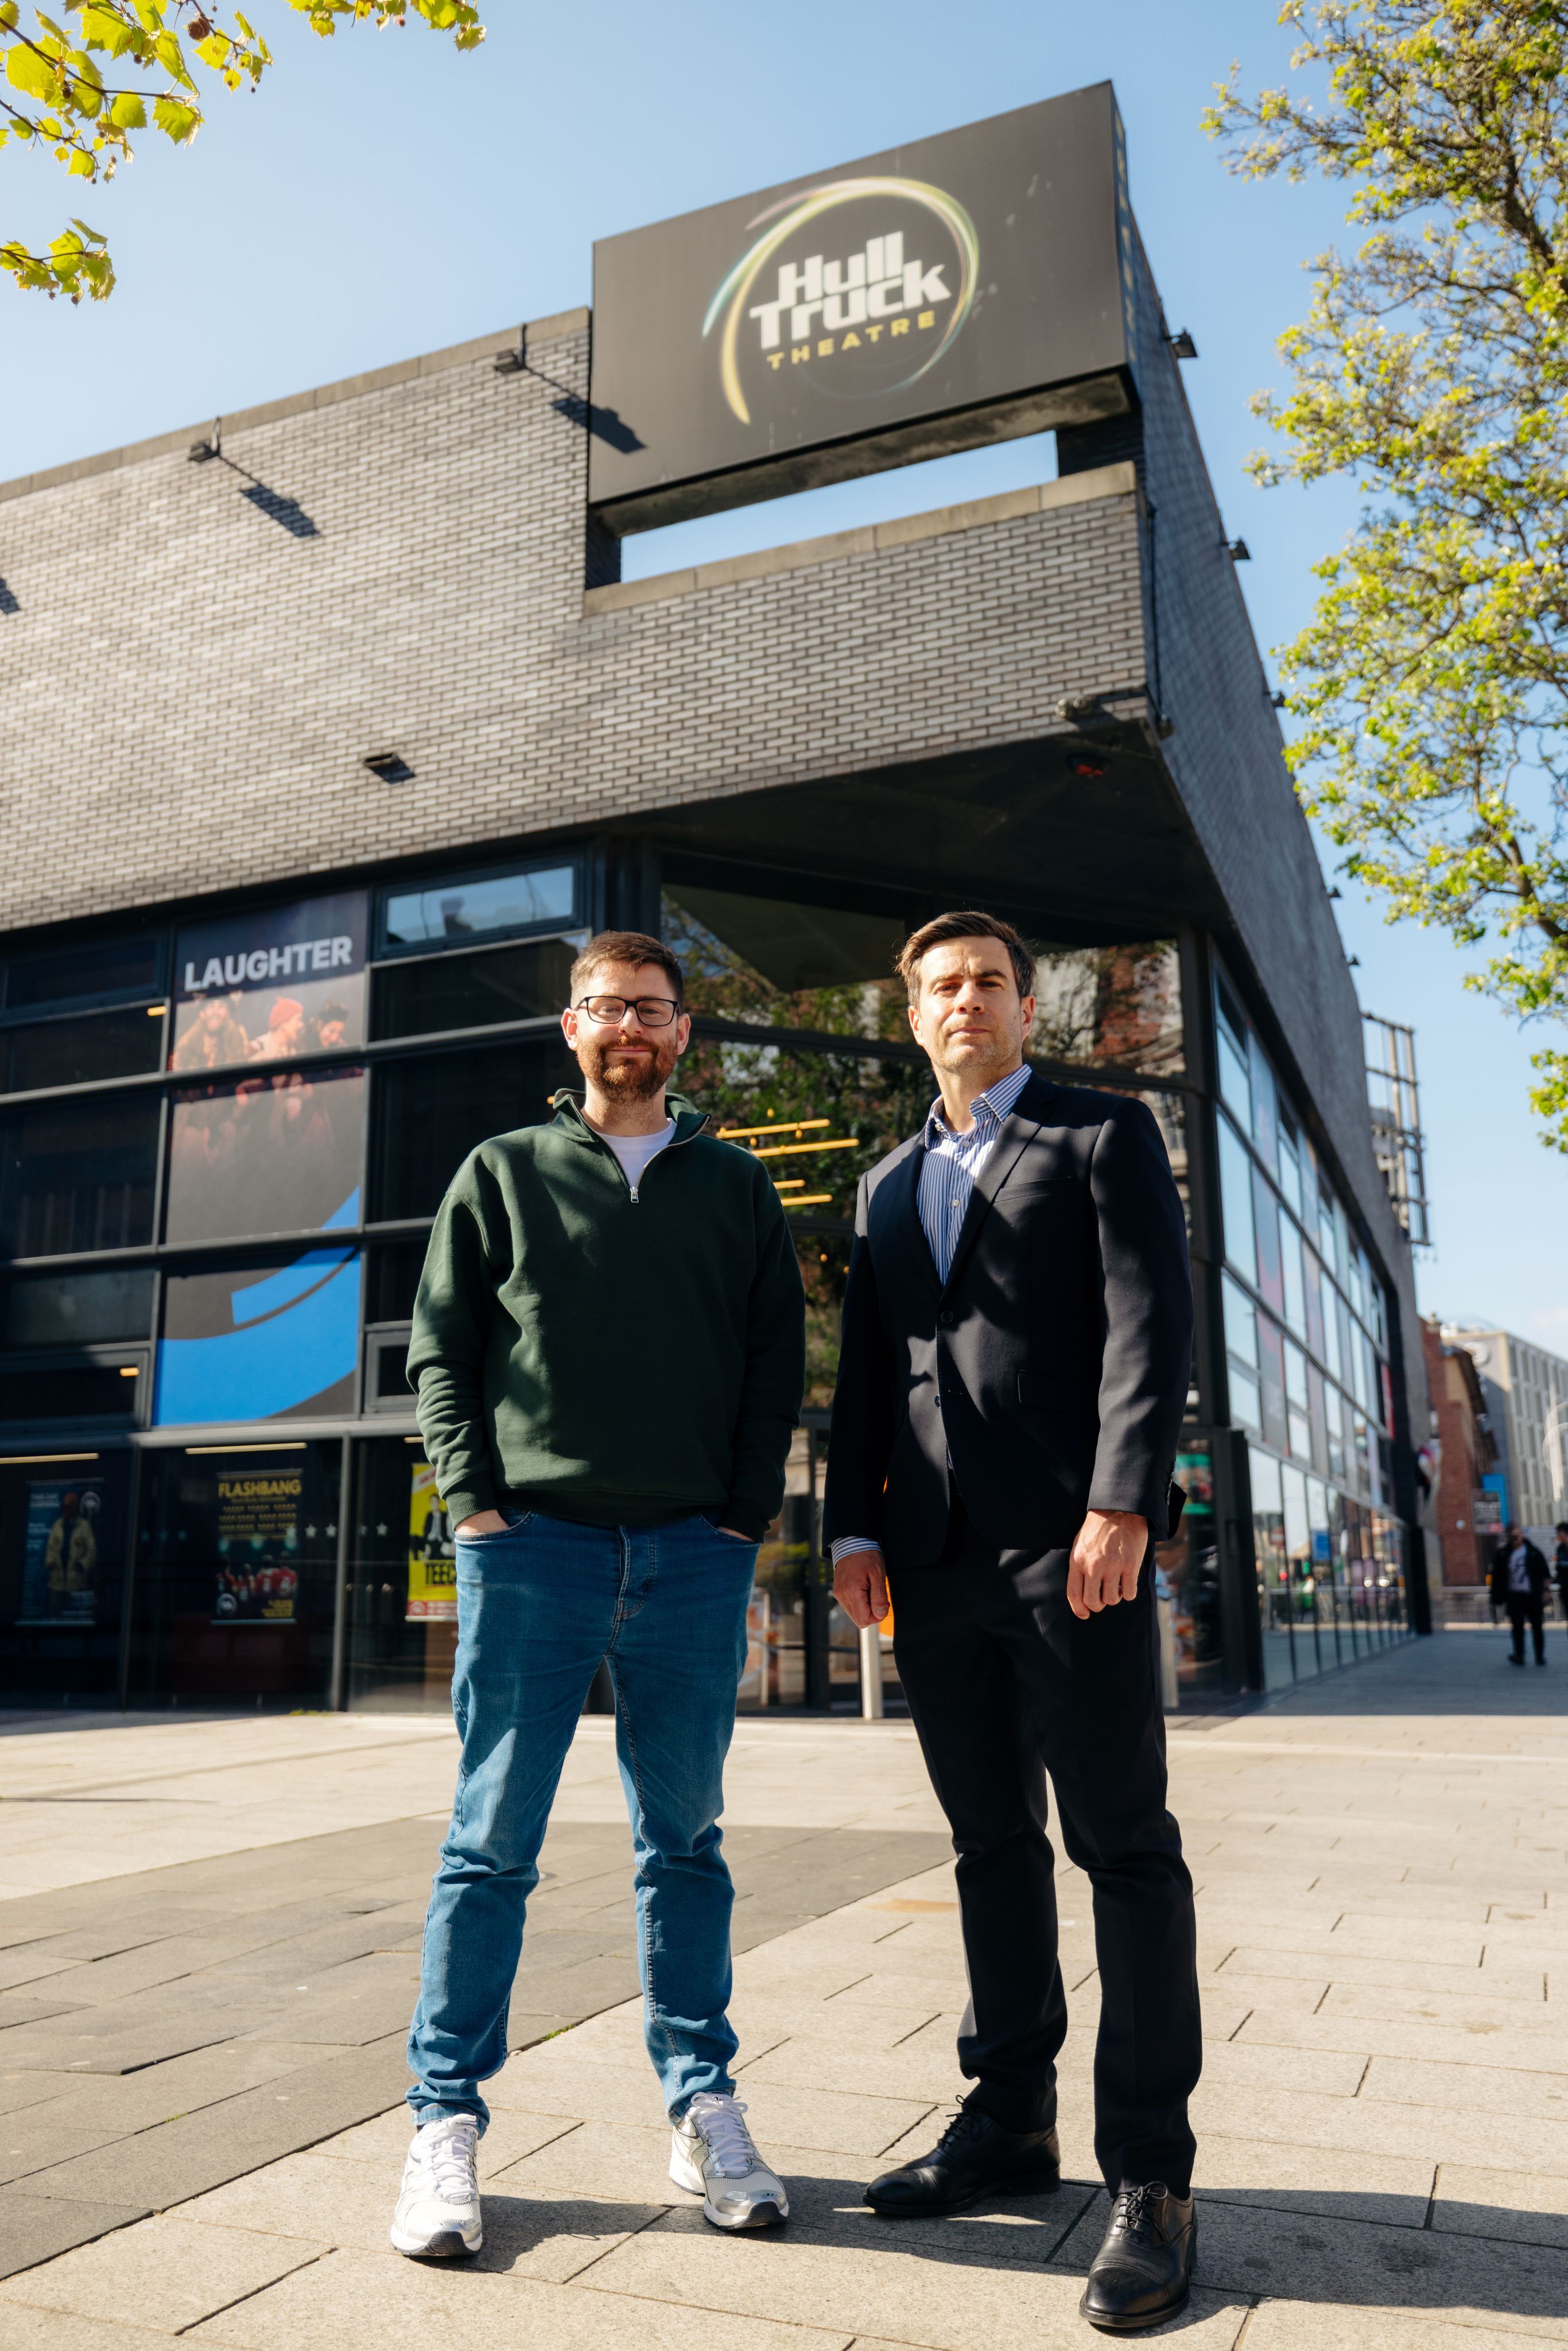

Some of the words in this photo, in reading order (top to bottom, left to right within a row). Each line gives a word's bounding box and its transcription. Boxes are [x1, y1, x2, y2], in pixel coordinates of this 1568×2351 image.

[778, 231, 903, 308] Hull
[749, 259, 951, 349] Truck
[766, 310, 936, 370] THEATRE
[184, 935, 352, 992] LAUGHTER
[218, 1479, 302, 1497] FLASHBANG
